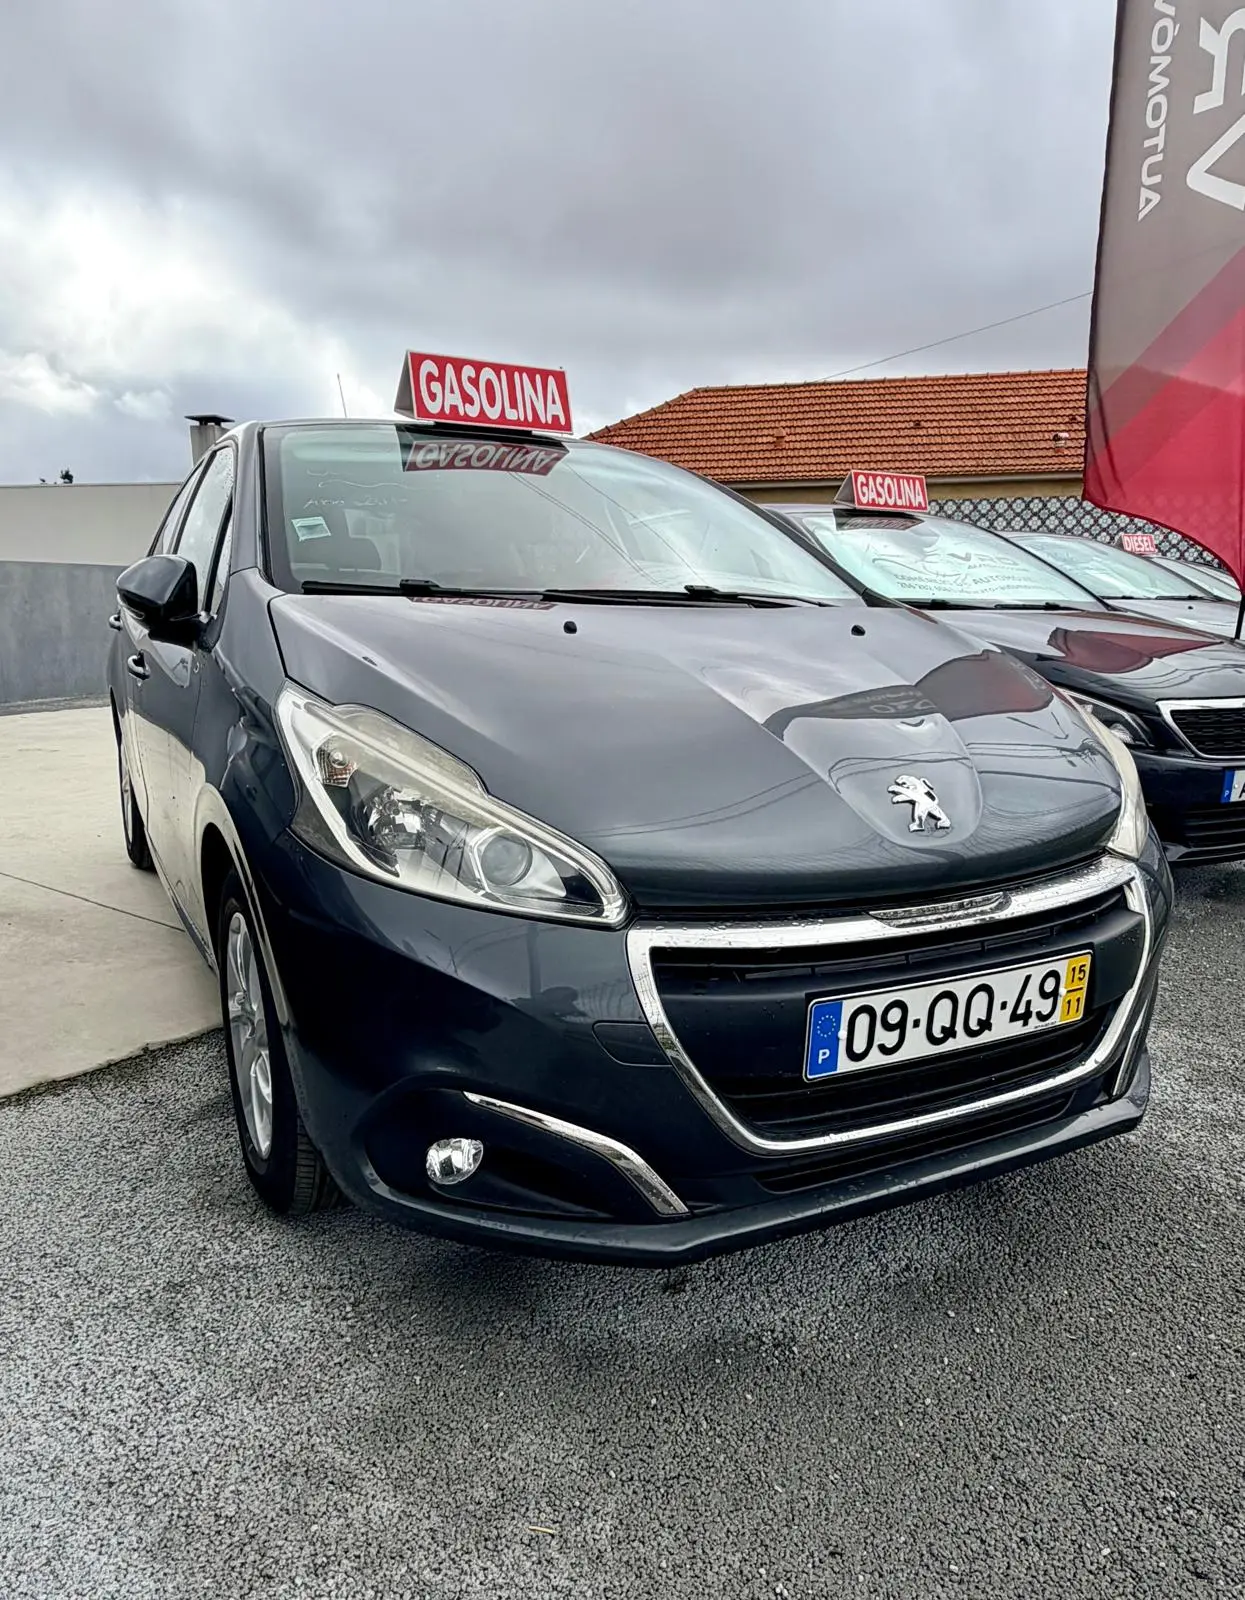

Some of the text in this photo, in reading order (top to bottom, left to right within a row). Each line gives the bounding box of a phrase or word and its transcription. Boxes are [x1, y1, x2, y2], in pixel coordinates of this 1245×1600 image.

[419, 359, 566, 426] GASOLINA
[857, 475, 926, 508] GASOLINA
[1123, 535, 1154, 552] DIESEL
[1071, 963, 1087, 984] 15
[1066, 996, 1081, 1016] 11
[818, 1049, 830, 1065] P
